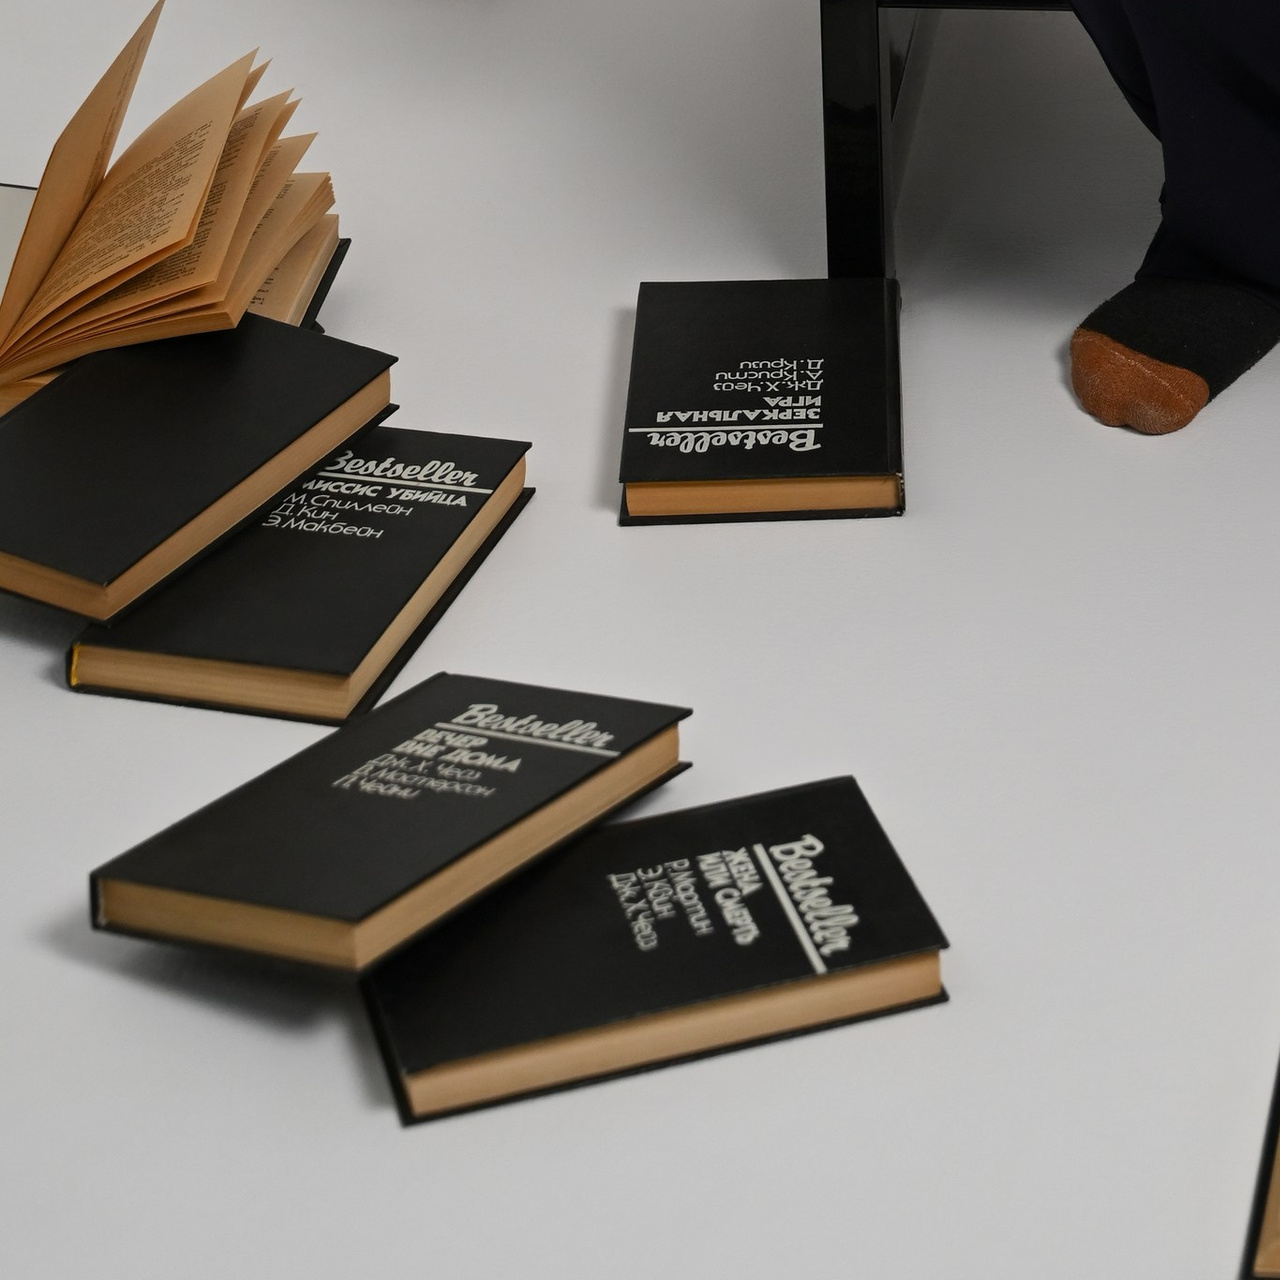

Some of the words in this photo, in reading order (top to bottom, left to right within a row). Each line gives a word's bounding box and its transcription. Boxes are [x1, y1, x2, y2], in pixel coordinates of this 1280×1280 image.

[763, 395, 822, 407] ИГРА
[656, 408, 821, 423] ЗЕРКАЛЬНАЯ
[647, 429, 822, 453] Bestseller
[386, 487, 468, 507] УБИЙЦА
[451, 703, 615, 748] Bestseller
[437, 748, 522, 773] ДОМА
[721, 846, 764, 897] ЖЕНА
[768, 832, 860, 957] Bestseller
[714, 887, 761, 946] СМЕРТЬ
